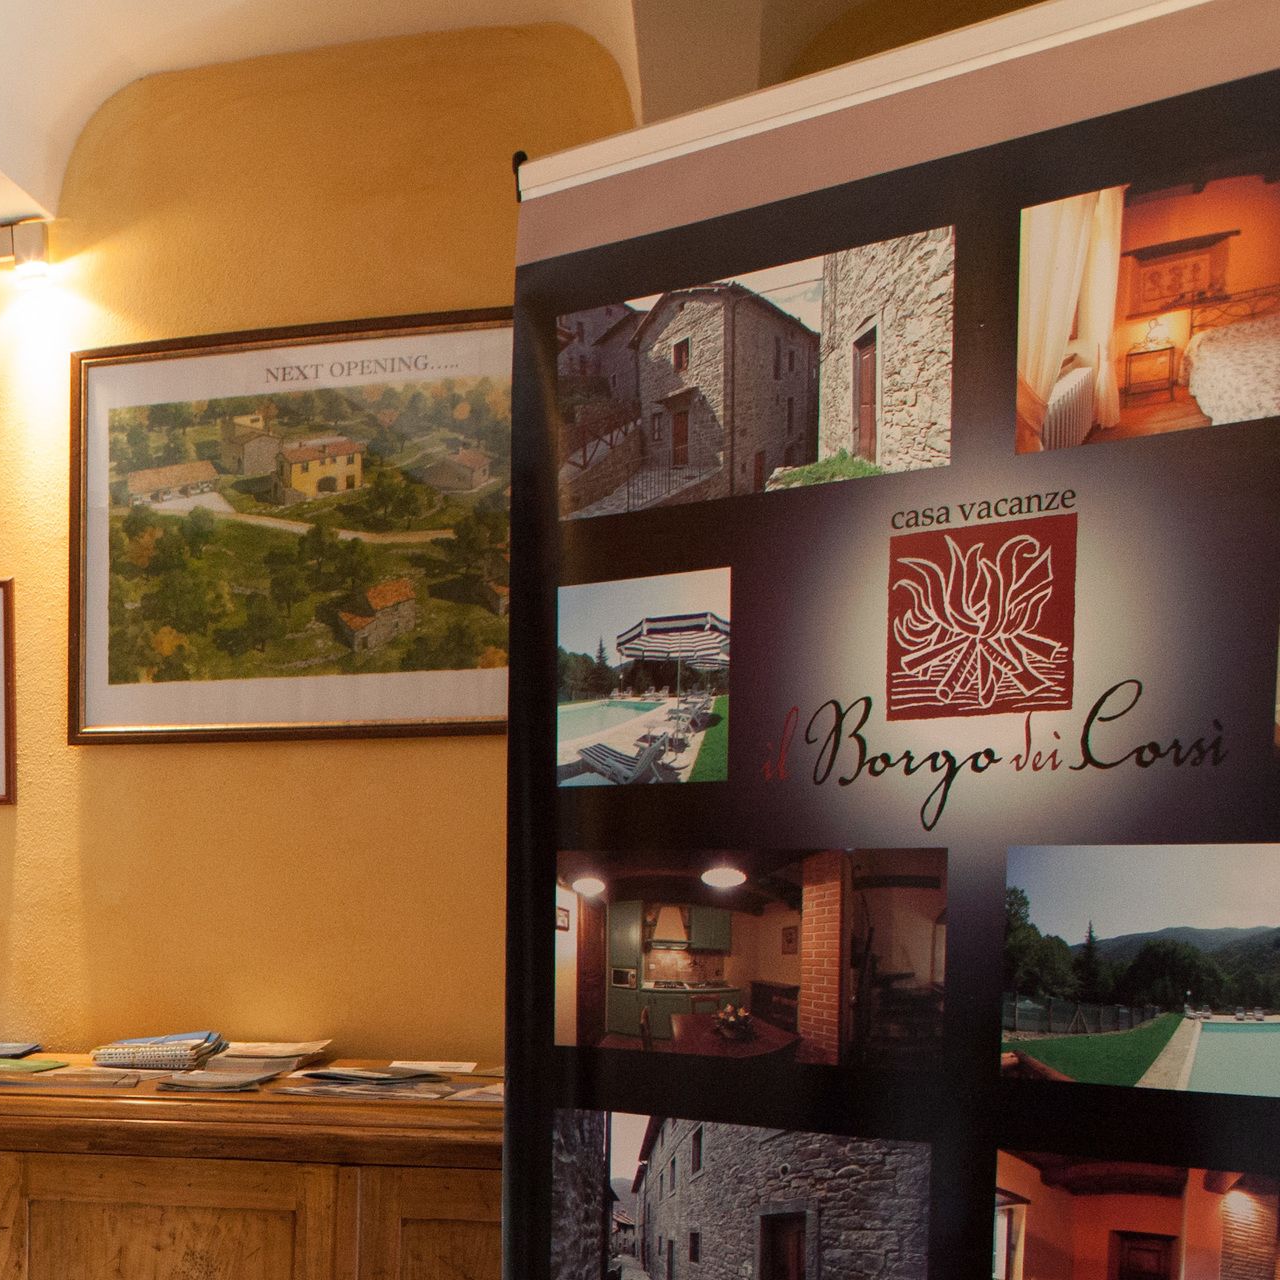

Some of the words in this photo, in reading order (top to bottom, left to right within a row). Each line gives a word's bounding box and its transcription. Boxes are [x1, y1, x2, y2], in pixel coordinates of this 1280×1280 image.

[265, 363, 324, 383] NEXT
[890, 504, 951, 530] casa
[956, 487, 1077, 522] vacanze
[804, 695, 1003, 832] Borgo
[1068, 678, 1228, 770] Corsi
